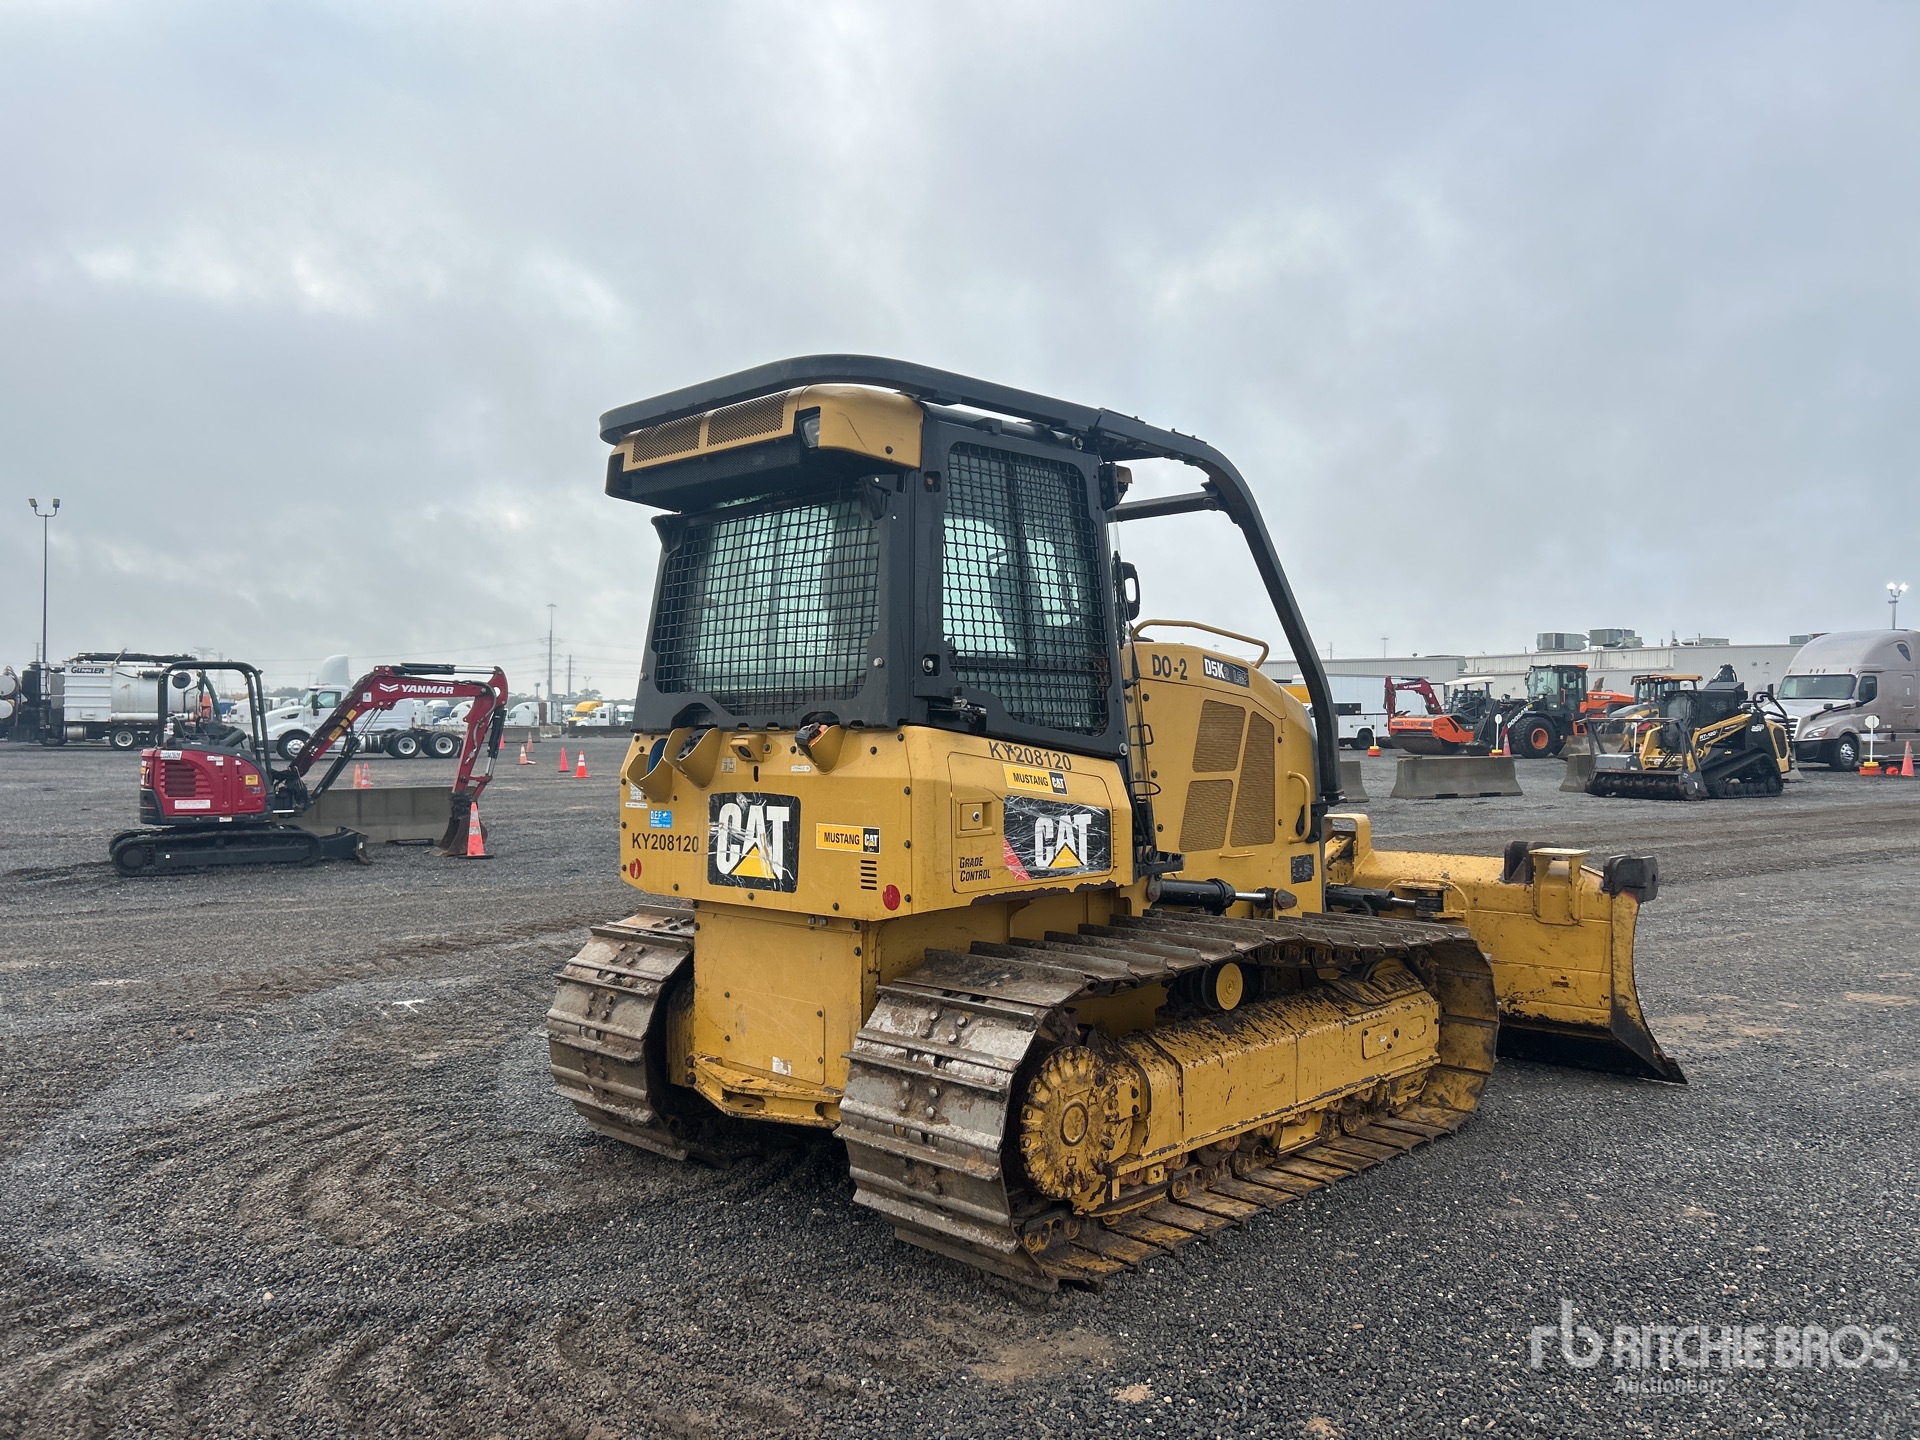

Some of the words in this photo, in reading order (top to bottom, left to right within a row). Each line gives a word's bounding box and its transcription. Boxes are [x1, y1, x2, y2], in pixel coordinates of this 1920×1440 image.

[1152, 654, 1188, 681] DO-2
[401, 684, 454, 694] YANMAR
[988, 741, 1072, 770] KY208120
[1013, 773, 1049, 787] MUSTANG
[1052, 776, 1065, 790] CAT
[632, 833, 699, 853] KY208120
[716, 802, 790, 880] CAT
[824, 832, 860, 845] MUSTANG
[864, 833, 879, 847] CAT
[1035, 814, 1092, 870] CAT
[959, 857, 983, 869] GRADE
[960, 869, 991, 882] CONTROL
